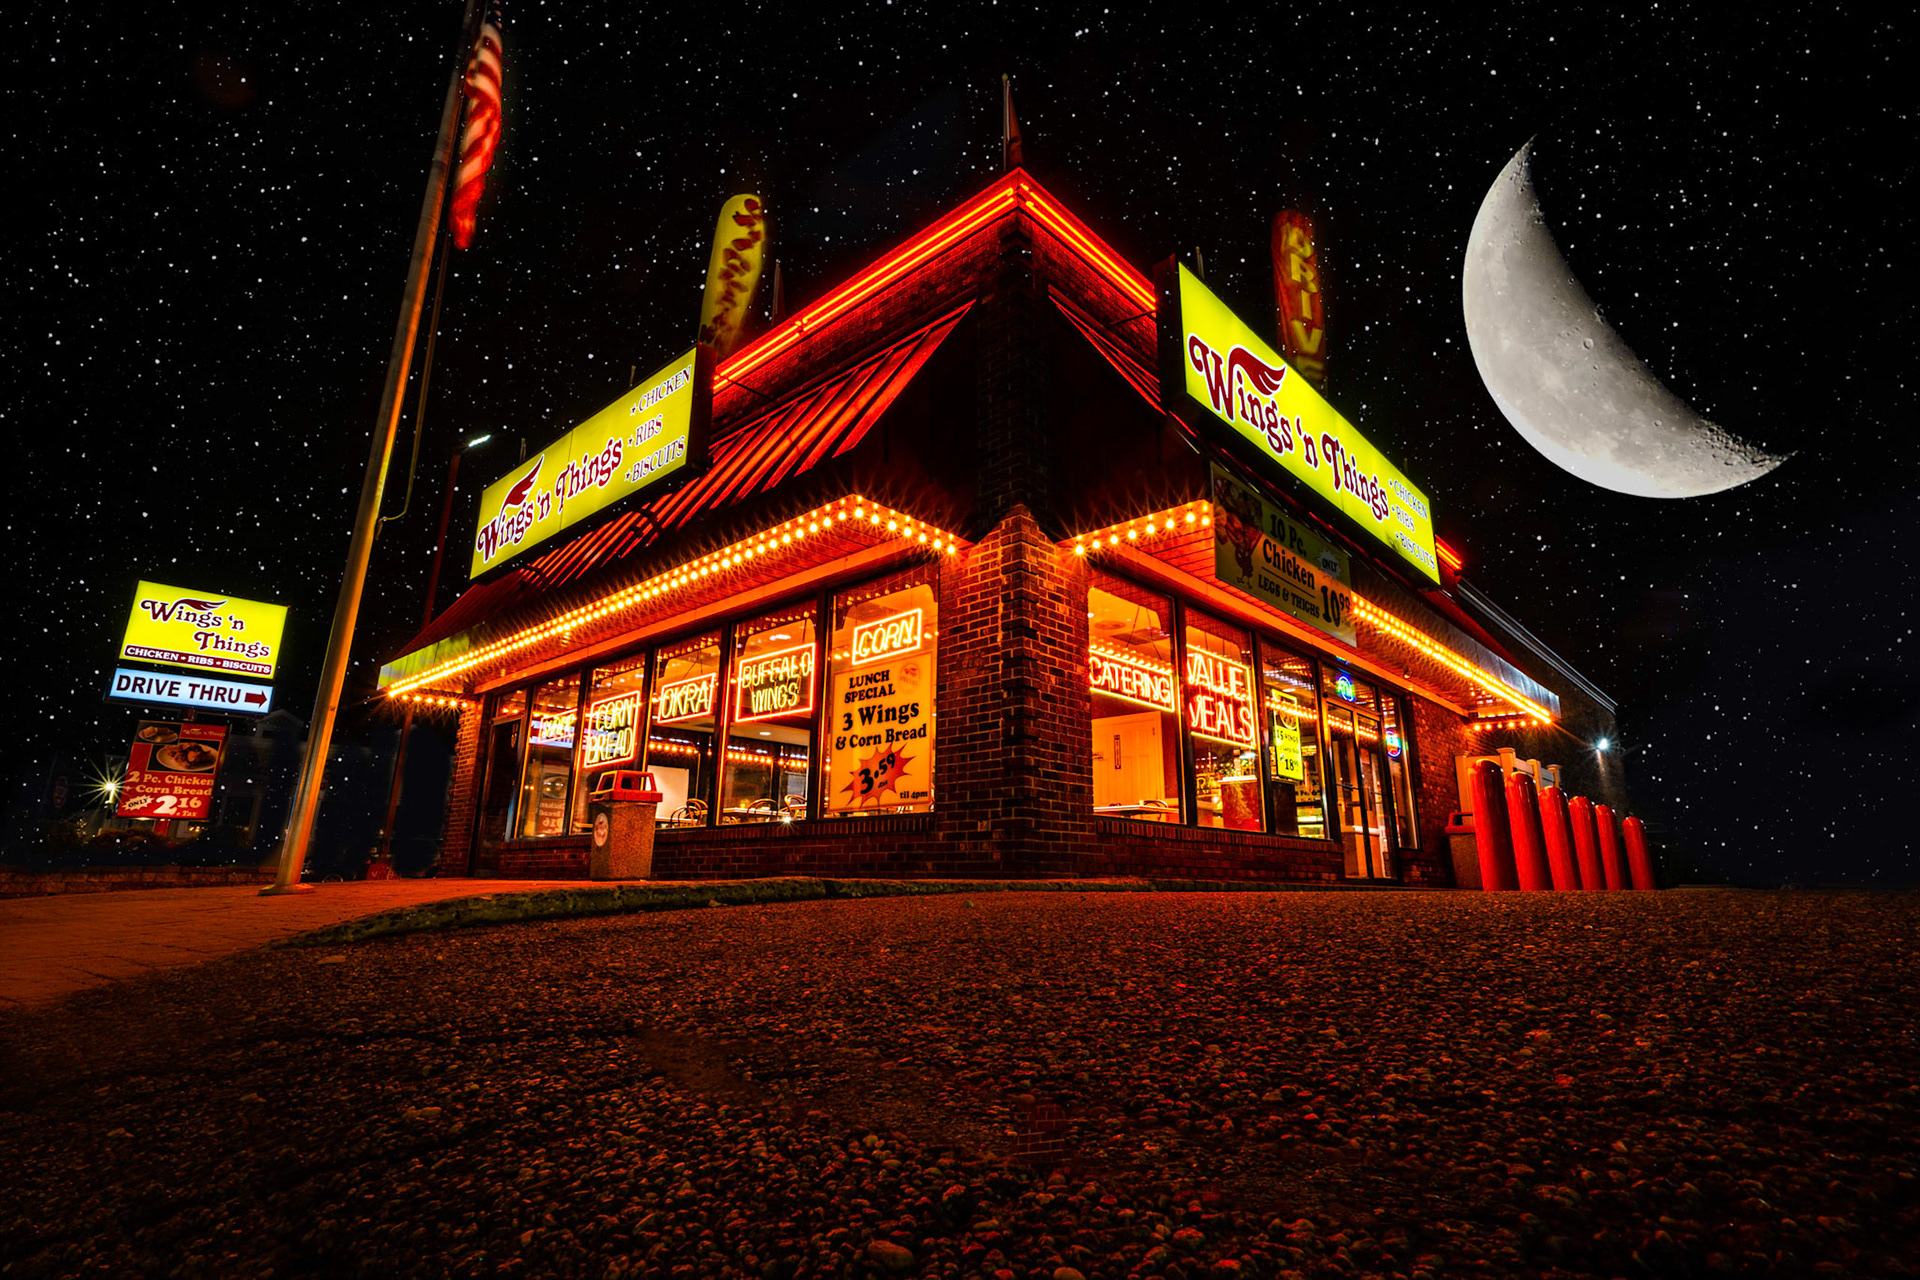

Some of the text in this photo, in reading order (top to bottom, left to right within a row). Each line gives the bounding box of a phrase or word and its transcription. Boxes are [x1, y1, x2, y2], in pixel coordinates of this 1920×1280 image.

[637, 365, 692, 412] CHICKEN
[635, 414, 663, 446] RIBS
[1188, 333, 1293, 457] Wings
[1321, 432, 1389, 523] Things
[631, 435, 686, 483] BISCUITS
[477, 490, 535, 563] Wings
[555, 437, 623, 513] Things
[1394, 480, 1428, 521] CHICKEN
[1270, 514, 1285, 541] 10
[1396, 504, 1415, 533] RIBS
[1263, 538, 1315, 590] Chicken
[1322, 557, 1338, 574] ONLY
[1399, 531, 1436, 570] BISCUITS
[1258, 573, 1281, 597] LEGS
[1290, 592, 1320, 619] THIGHS
[141, 599, 223, 628] Wings
[194, 632, 271, 658] Things
[859, 616, 915, 658] CORN
[126, 646, 271, 674] CHICKEN RIBS BISCUITS
[742, 652, 811, 689] BUFFALO
[116, 675, 242, 704] DRIVE THRU
[849, 670, 890, 689] LUNCH
[1089, 657, 1171, 703] CATERING
[1187, 653, 1245, 701] VALUE
[661, 681, 709, 719] OKRA
[752, 682, 798, 714] WINGS
[844, 683, 896, 704] SPECIAL
[595, 697, 634, 732] CORN
[842, 702, 920, 732] 3 Wings
[587, 728, 633, 763] BREAD
[835, 724, 927, 750] & Corn Bread
[126, 771, 214, 785] 2 Pc. Chicken
[858, 752, 896, 794] 3.59
[128, 797, 148, 808] ONLY
[135, 784, 170, 794] Corn
[173, 785, 212, 796] Bread
[911, 791, 928, 800] 4pm
